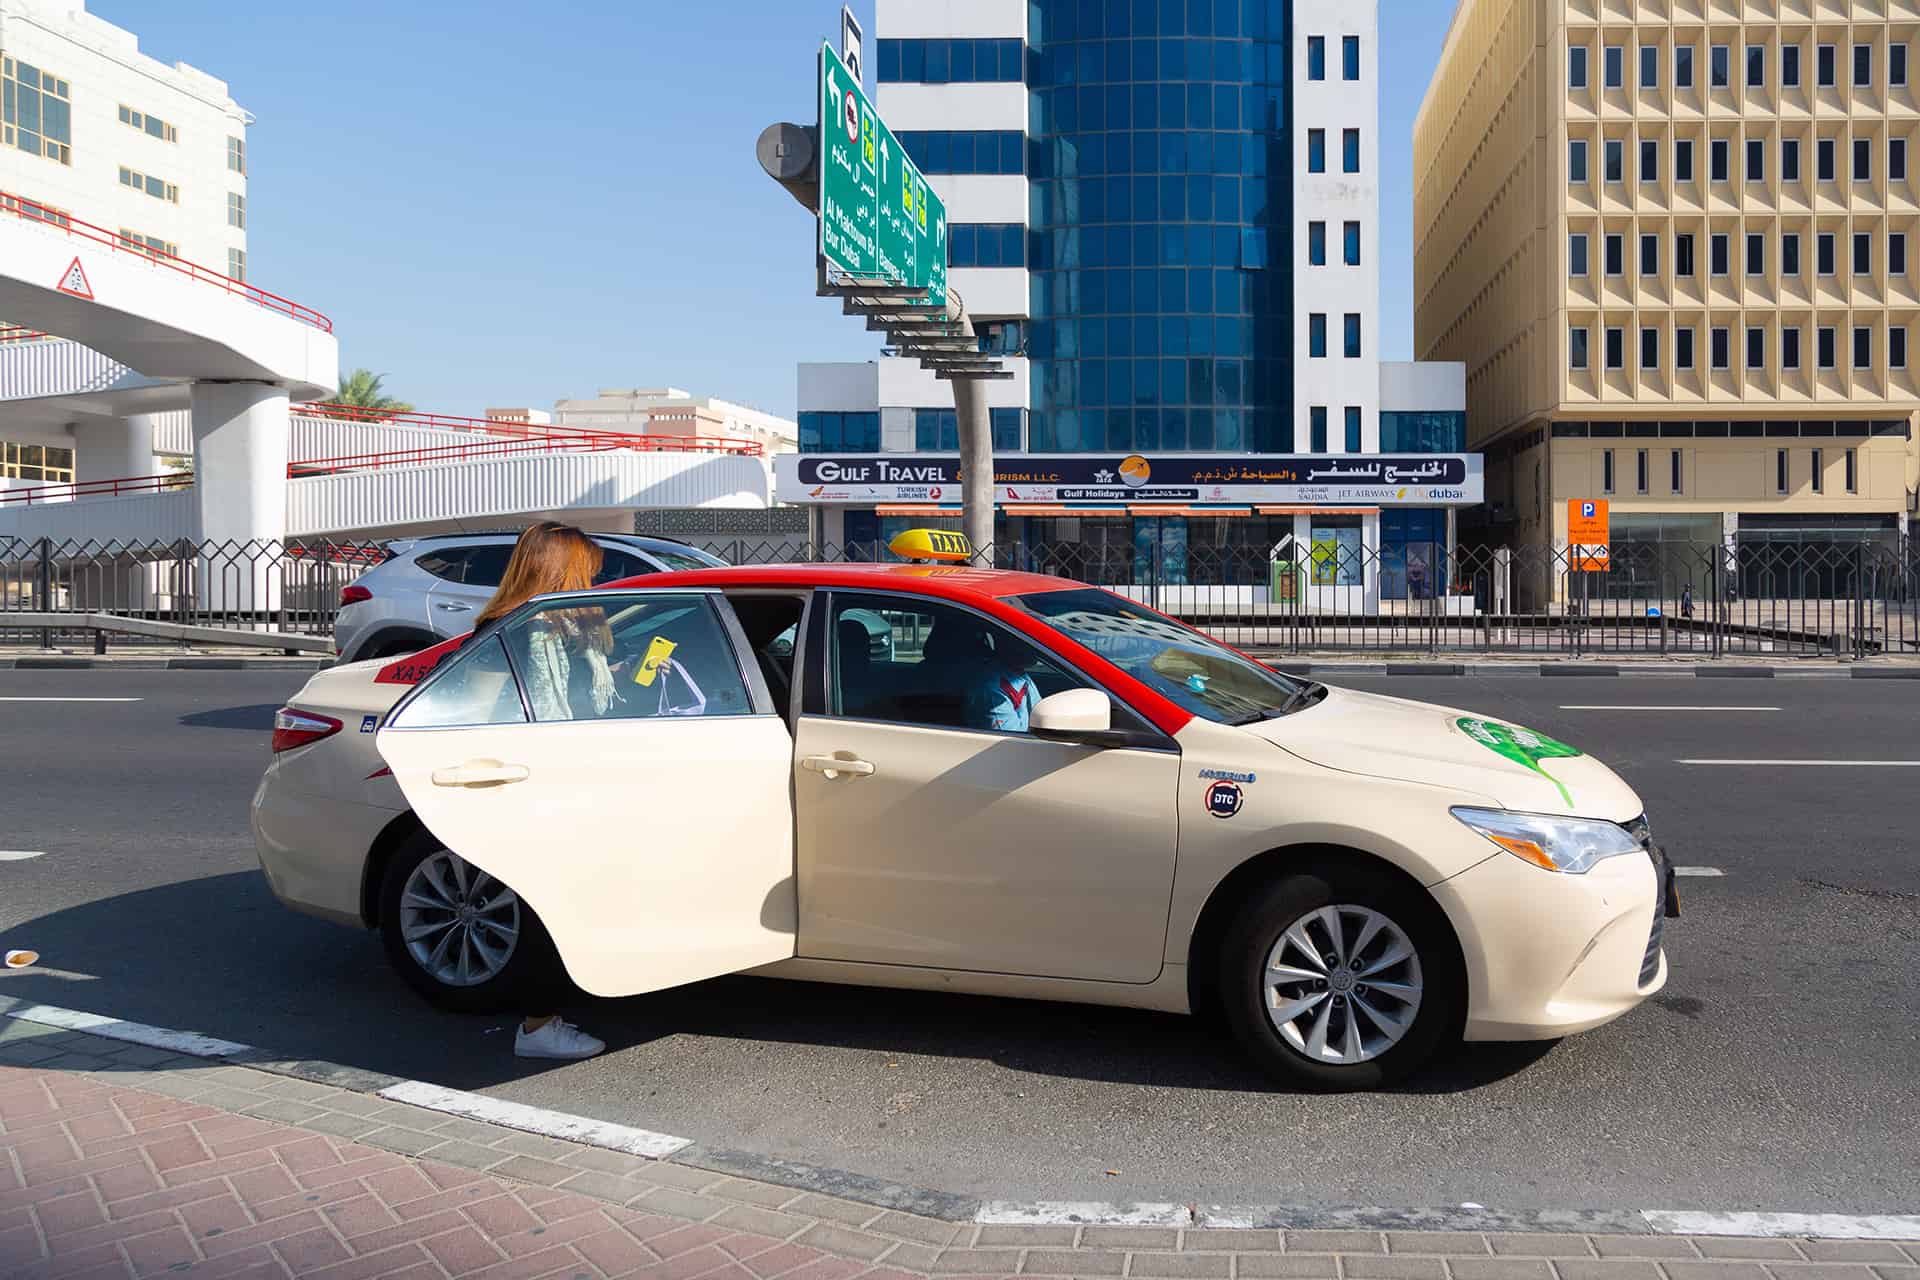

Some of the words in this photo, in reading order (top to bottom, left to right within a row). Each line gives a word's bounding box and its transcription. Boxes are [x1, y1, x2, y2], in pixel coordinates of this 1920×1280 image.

[836, 204, 867, 250] Maktoum
[826, 222, 839, 249] Bur
[841, 235, 860, 269] Dubai
[816, 461, 870, 481] GULF
[876, 461, 946, 481] TRAVEL
[1307, 460, 1381, 481] للسفر
[1384, 460, 1448, 483] الخليج
[1064, 490, 1082, 498] Gulf
[1086, 490, 1125, 499] Holidays
[1338, 489, 1353, 498] JET
[1355, 489, 1395, 497] AIRWAYS
[1583, 503, 1593, 516] P
[934, 534, 966, 553] TAXI
[1214, 793, 1234, 805] DTC
